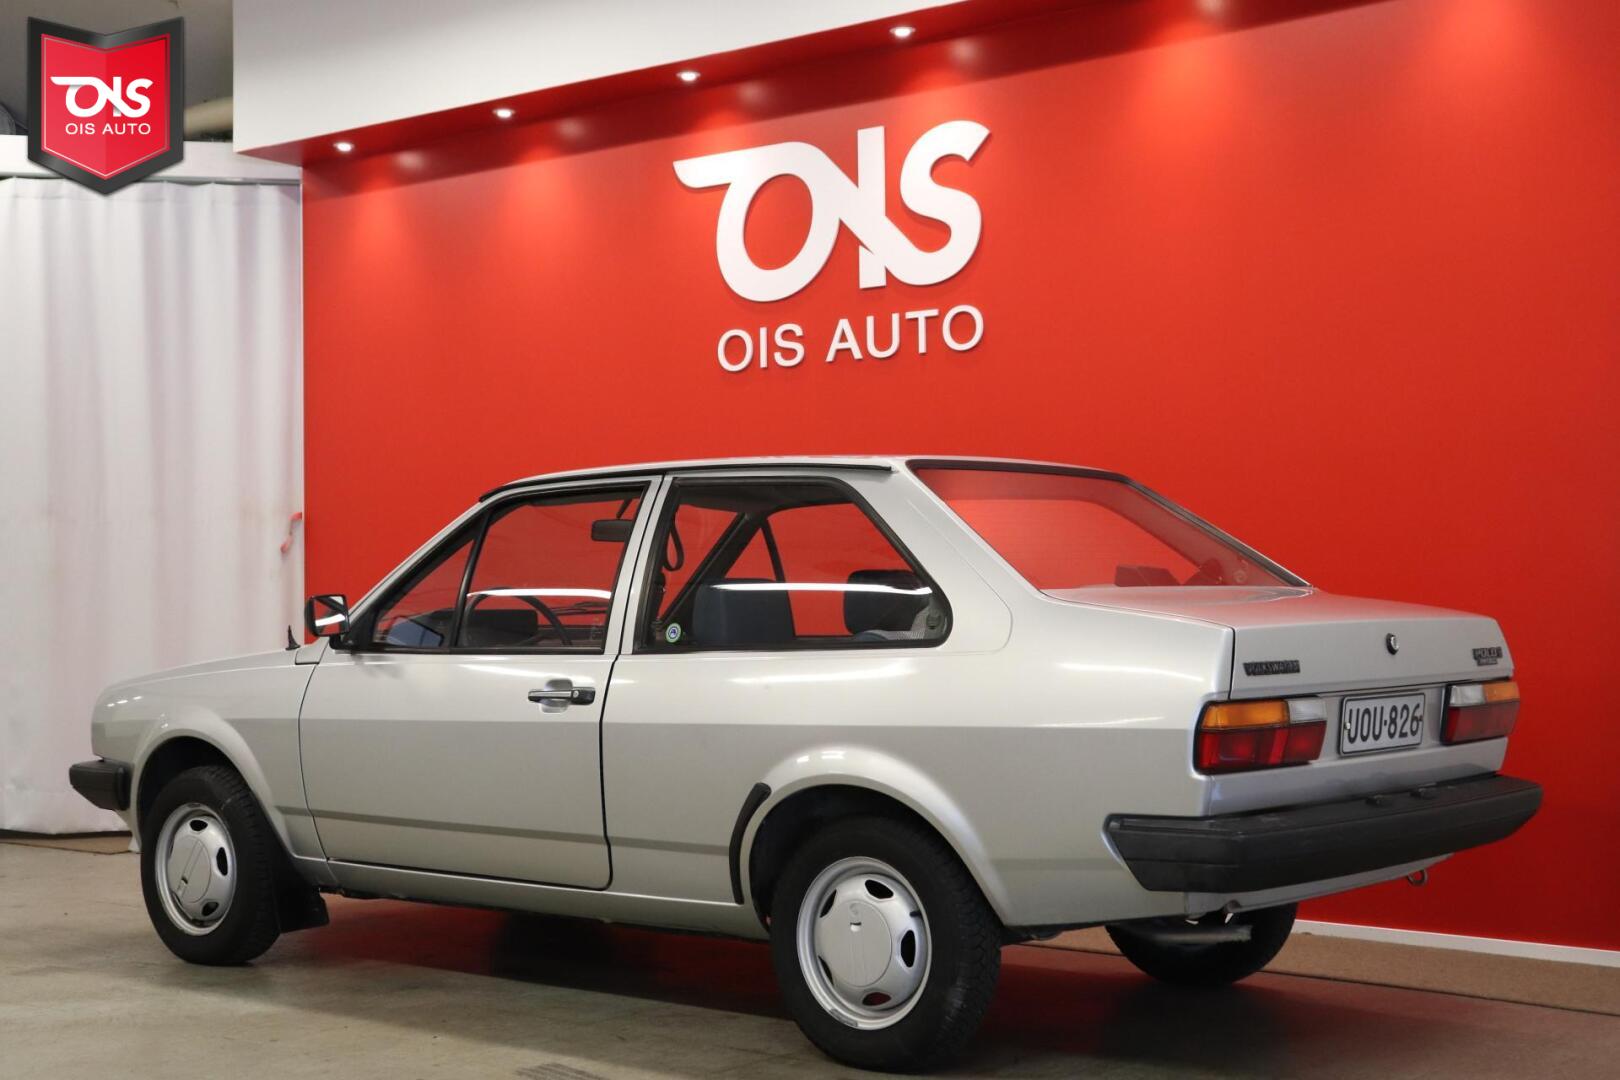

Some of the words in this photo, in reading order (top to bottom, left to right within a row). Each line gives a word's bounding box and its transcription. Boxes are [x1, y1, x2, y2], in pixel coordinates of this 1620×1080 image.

[717, 323, 805, 372] OIS
[825, 304, 985, 363] AUTO
[1347, 703, 1421, 744] UOU-826
